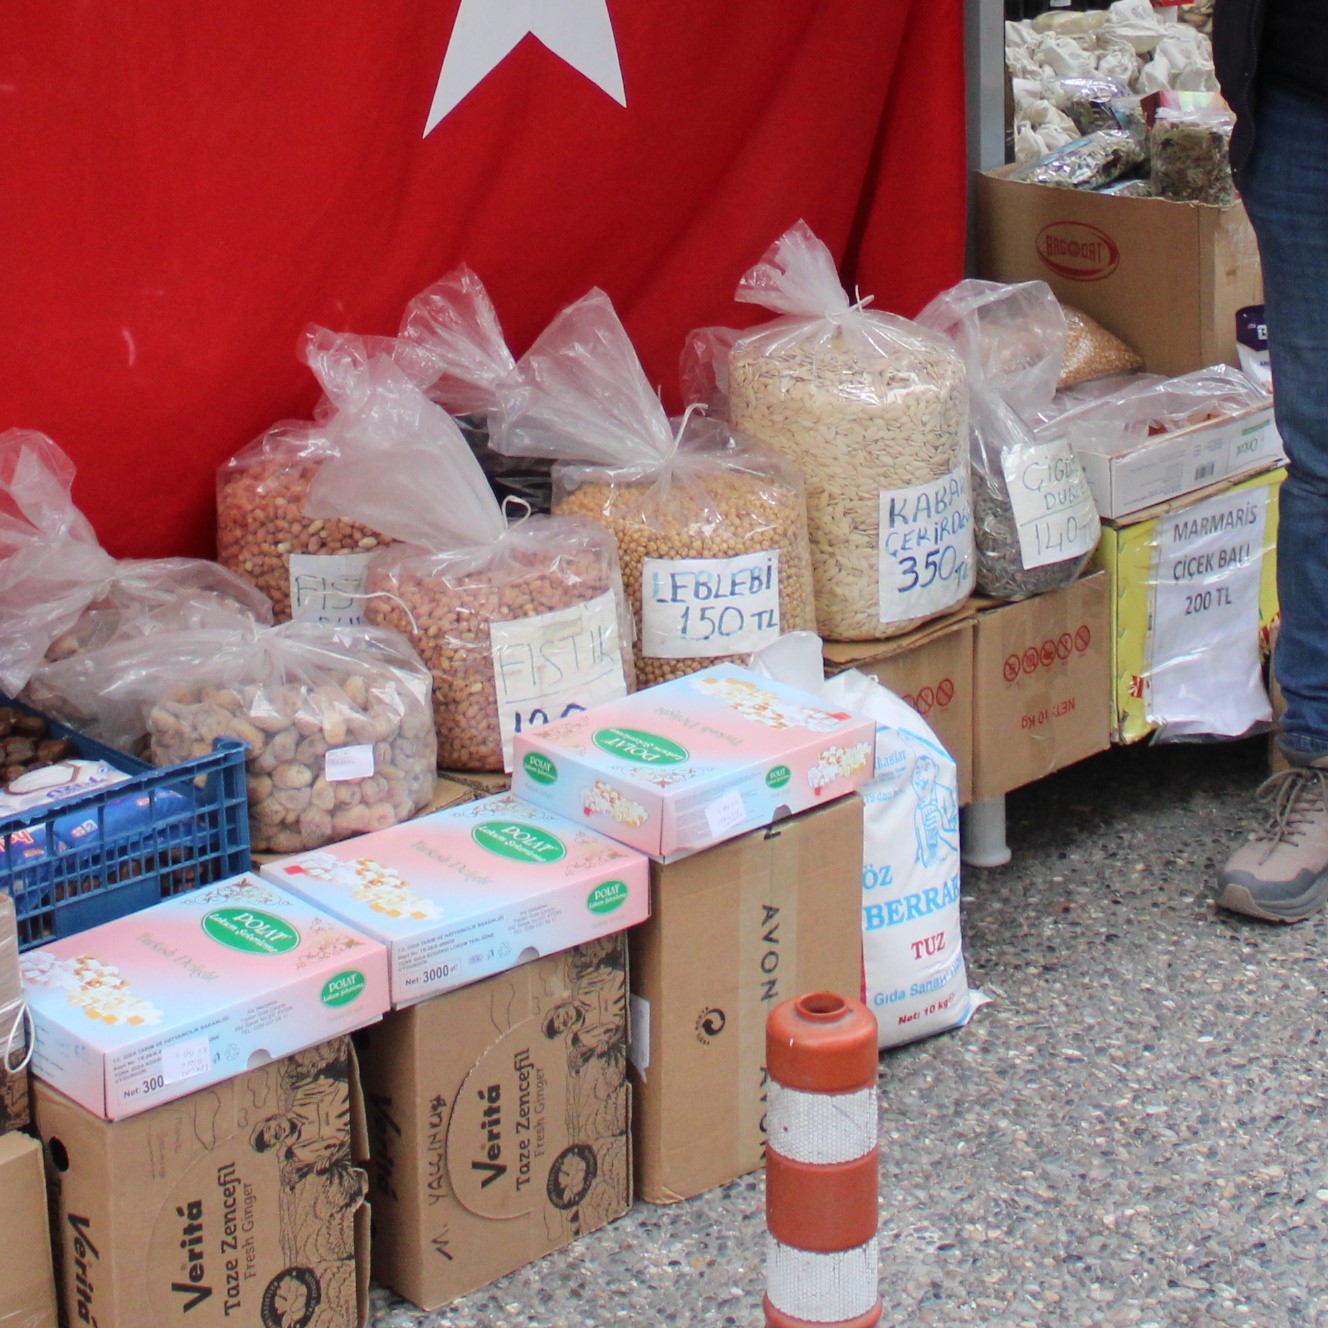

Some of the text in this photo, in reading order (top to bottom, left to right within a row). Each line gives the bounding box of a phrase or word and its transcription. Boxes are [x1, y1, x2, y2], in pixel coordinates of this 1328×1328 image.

[1173, 501, 1258, 543] MARMARİS
[652, 557, 773, 603] LEBLEBİ
[1173, 553, 1213, 584] ÇİÇEK
[1185, 586, 1232, 616] 200 TL
[680, 605, 778, 641] 150 TL
[604, 738, 661, 762] POLAT
[500, 825, 560, 853] POLAT
[862, 863, 894, 891] ÖZ
[232, 911, 293, 942] POLAT
[911, 931, 945, 961] TUZ
[328, 972, 357, 993] POLAT
[423, 964, 450, 984] 3000
[874, 988, 907, 1007] Gıda
[898, 1011, 921, 1026] Net:
[924, 1002, 937, 1015] 10
[123, 1074, 165, 1100] Net: 300
[514, 1047, 534, 1192] Taze Zencefil
[534, 1067, 548, 1159] Fresh Ginger
[471, 1082, 509, 1190] Veritá
[219, 1161, 243, 1317] Taze Zencefil
[170, 1199, 213, 1314] Veritá
[243, 1235, 257, 1282] Fresh
